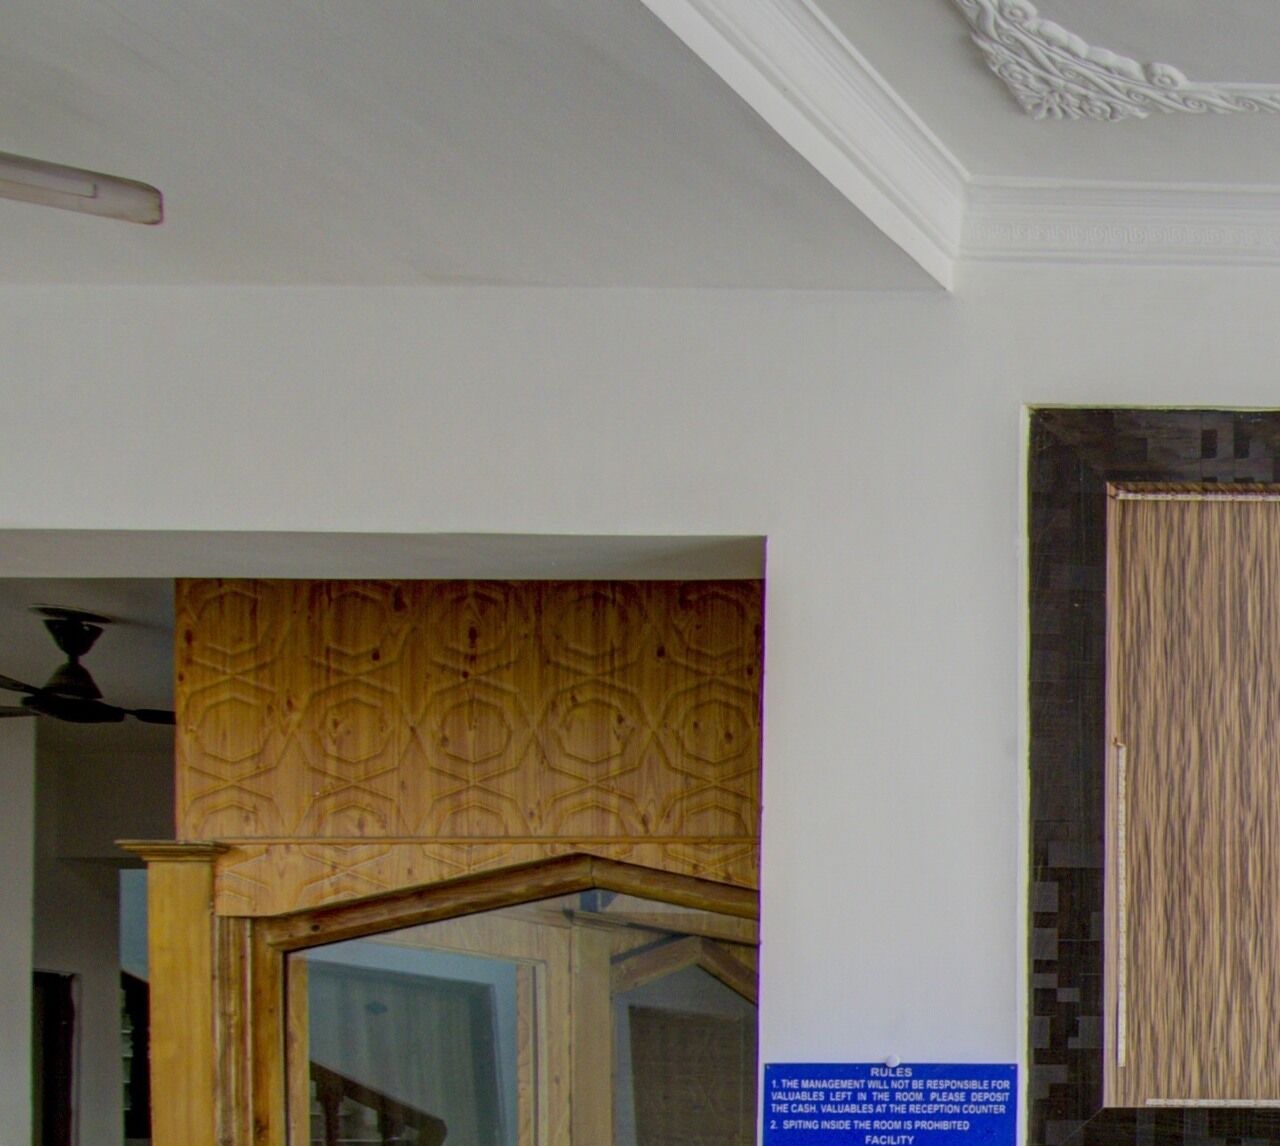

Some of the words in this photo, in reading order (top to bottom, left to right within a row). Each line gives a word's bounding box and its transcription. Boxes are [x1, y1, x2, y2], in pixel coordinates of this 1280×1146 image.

[870, 1067, 912, 1078] RULES
[771, 1079, 780, 1089] 1.
[781, 1079, 799, 1089] THE
[801, 1079, 866, 1089] MANAGEMENT
[867, 1079, 889, 1089] WILL
[891, 1080, 910, 1089] NOT
[912, 1080, 925, 1090] BE
[926, 1080, 989, 1090] RESPONSIBLE
[991, 1080, 1010, 1090] FOR
[771, 1091, 825, 1101] VALUABLES
[829, 1091, 852, 1101] LEFT
[857, 1092, 867, 1101] IN
[872, 1092, 890, 1101] THE
[930, 1092, 966, 1102] PLEASE
[971, 1092, 1010, 1102] DEPOSIT
[771, 1103, 789, 1113] THE
[820, 1103, 874, 1113] VALUABLES
[875, 1103, 887, 1113] AT
[889, 1104, 907, 1114] THE
[909, 1104, 960, 1114] RECEPTION
[962, 1104, 1006, 1114] COUNTER
[769, 1120, 779, 1130] 2.
[782, 1120, 819, 1130] SPITING
[821, 1120, 851, 1130] INSIDE
[853, 1120, 871, 1130] THE
[873, 1120, 902, 1130] ROOM
[903, 1120, 913, 1130] IS
[914, 1120, 970, 1130] PROHIBITED
[865, 1135, 914, 1145] FACILITY
